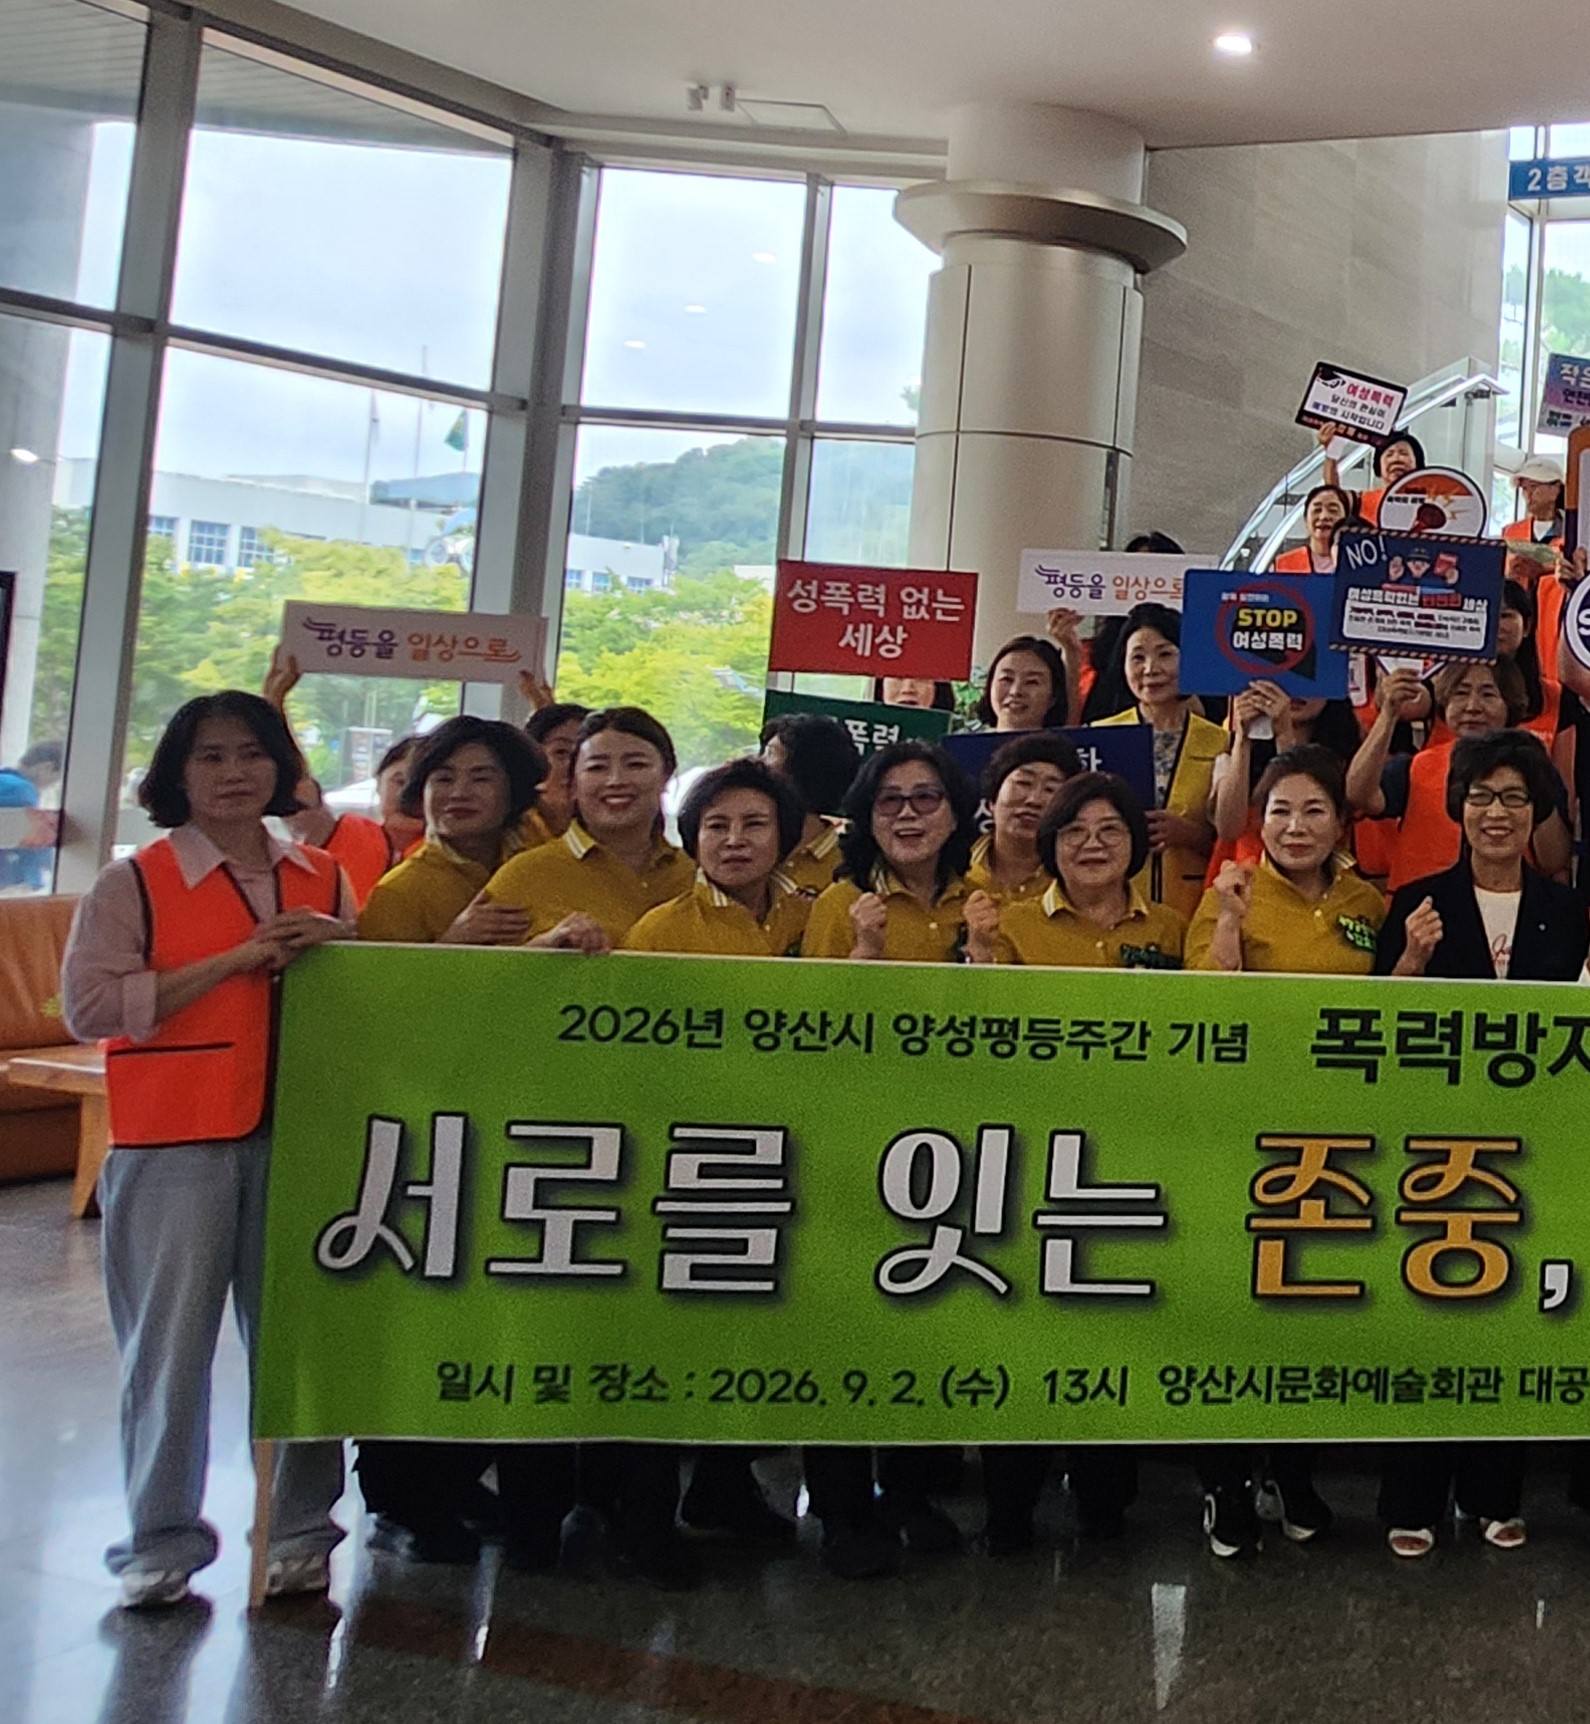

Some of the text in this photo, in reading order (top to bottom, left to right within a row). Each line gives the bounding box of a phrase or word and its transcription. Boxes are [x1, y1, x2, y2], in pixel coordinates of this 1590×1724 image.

[1346, 383, 1395, 408] 여성폭력
[1345, 534, 1388, 570] NO!
[787, 579, 965, 621] 성폭력 없는
[1035, 564, 1183, 601] 평등을 일상으로
[1238, 609, 1298, 628] STOP
[303, 616, 522, 663] 평등을 일상으로
[838, 623, 908, 659] 세상
[1233, 631, 1303, 650] 여성폭력
[556, 1003, 1251, 1063] 2026년 양산시 양성평등주간 기념
[313, 1110, 796, 1298] 서로를
[872, 1123, 1168, 1304] 잇는
[1244, 1129, 1575, 1313] 존중,
[437, 1361, 514, 1405] 일시
[532, 1364, 572, 1402] 및
[590, 1364, 670, 1403] 장소
[709, 1367, 828, 1406] 2026.
[843, 1367, 876, 1406] 9.
[891, 1367, 925, 1406] 2.
[941, 1366, 1010, 1408] (수)
[1042, 1365, 1129, 1407] 13시
[1157, 1365, 1503, 1406] 양산시문화예술회관
